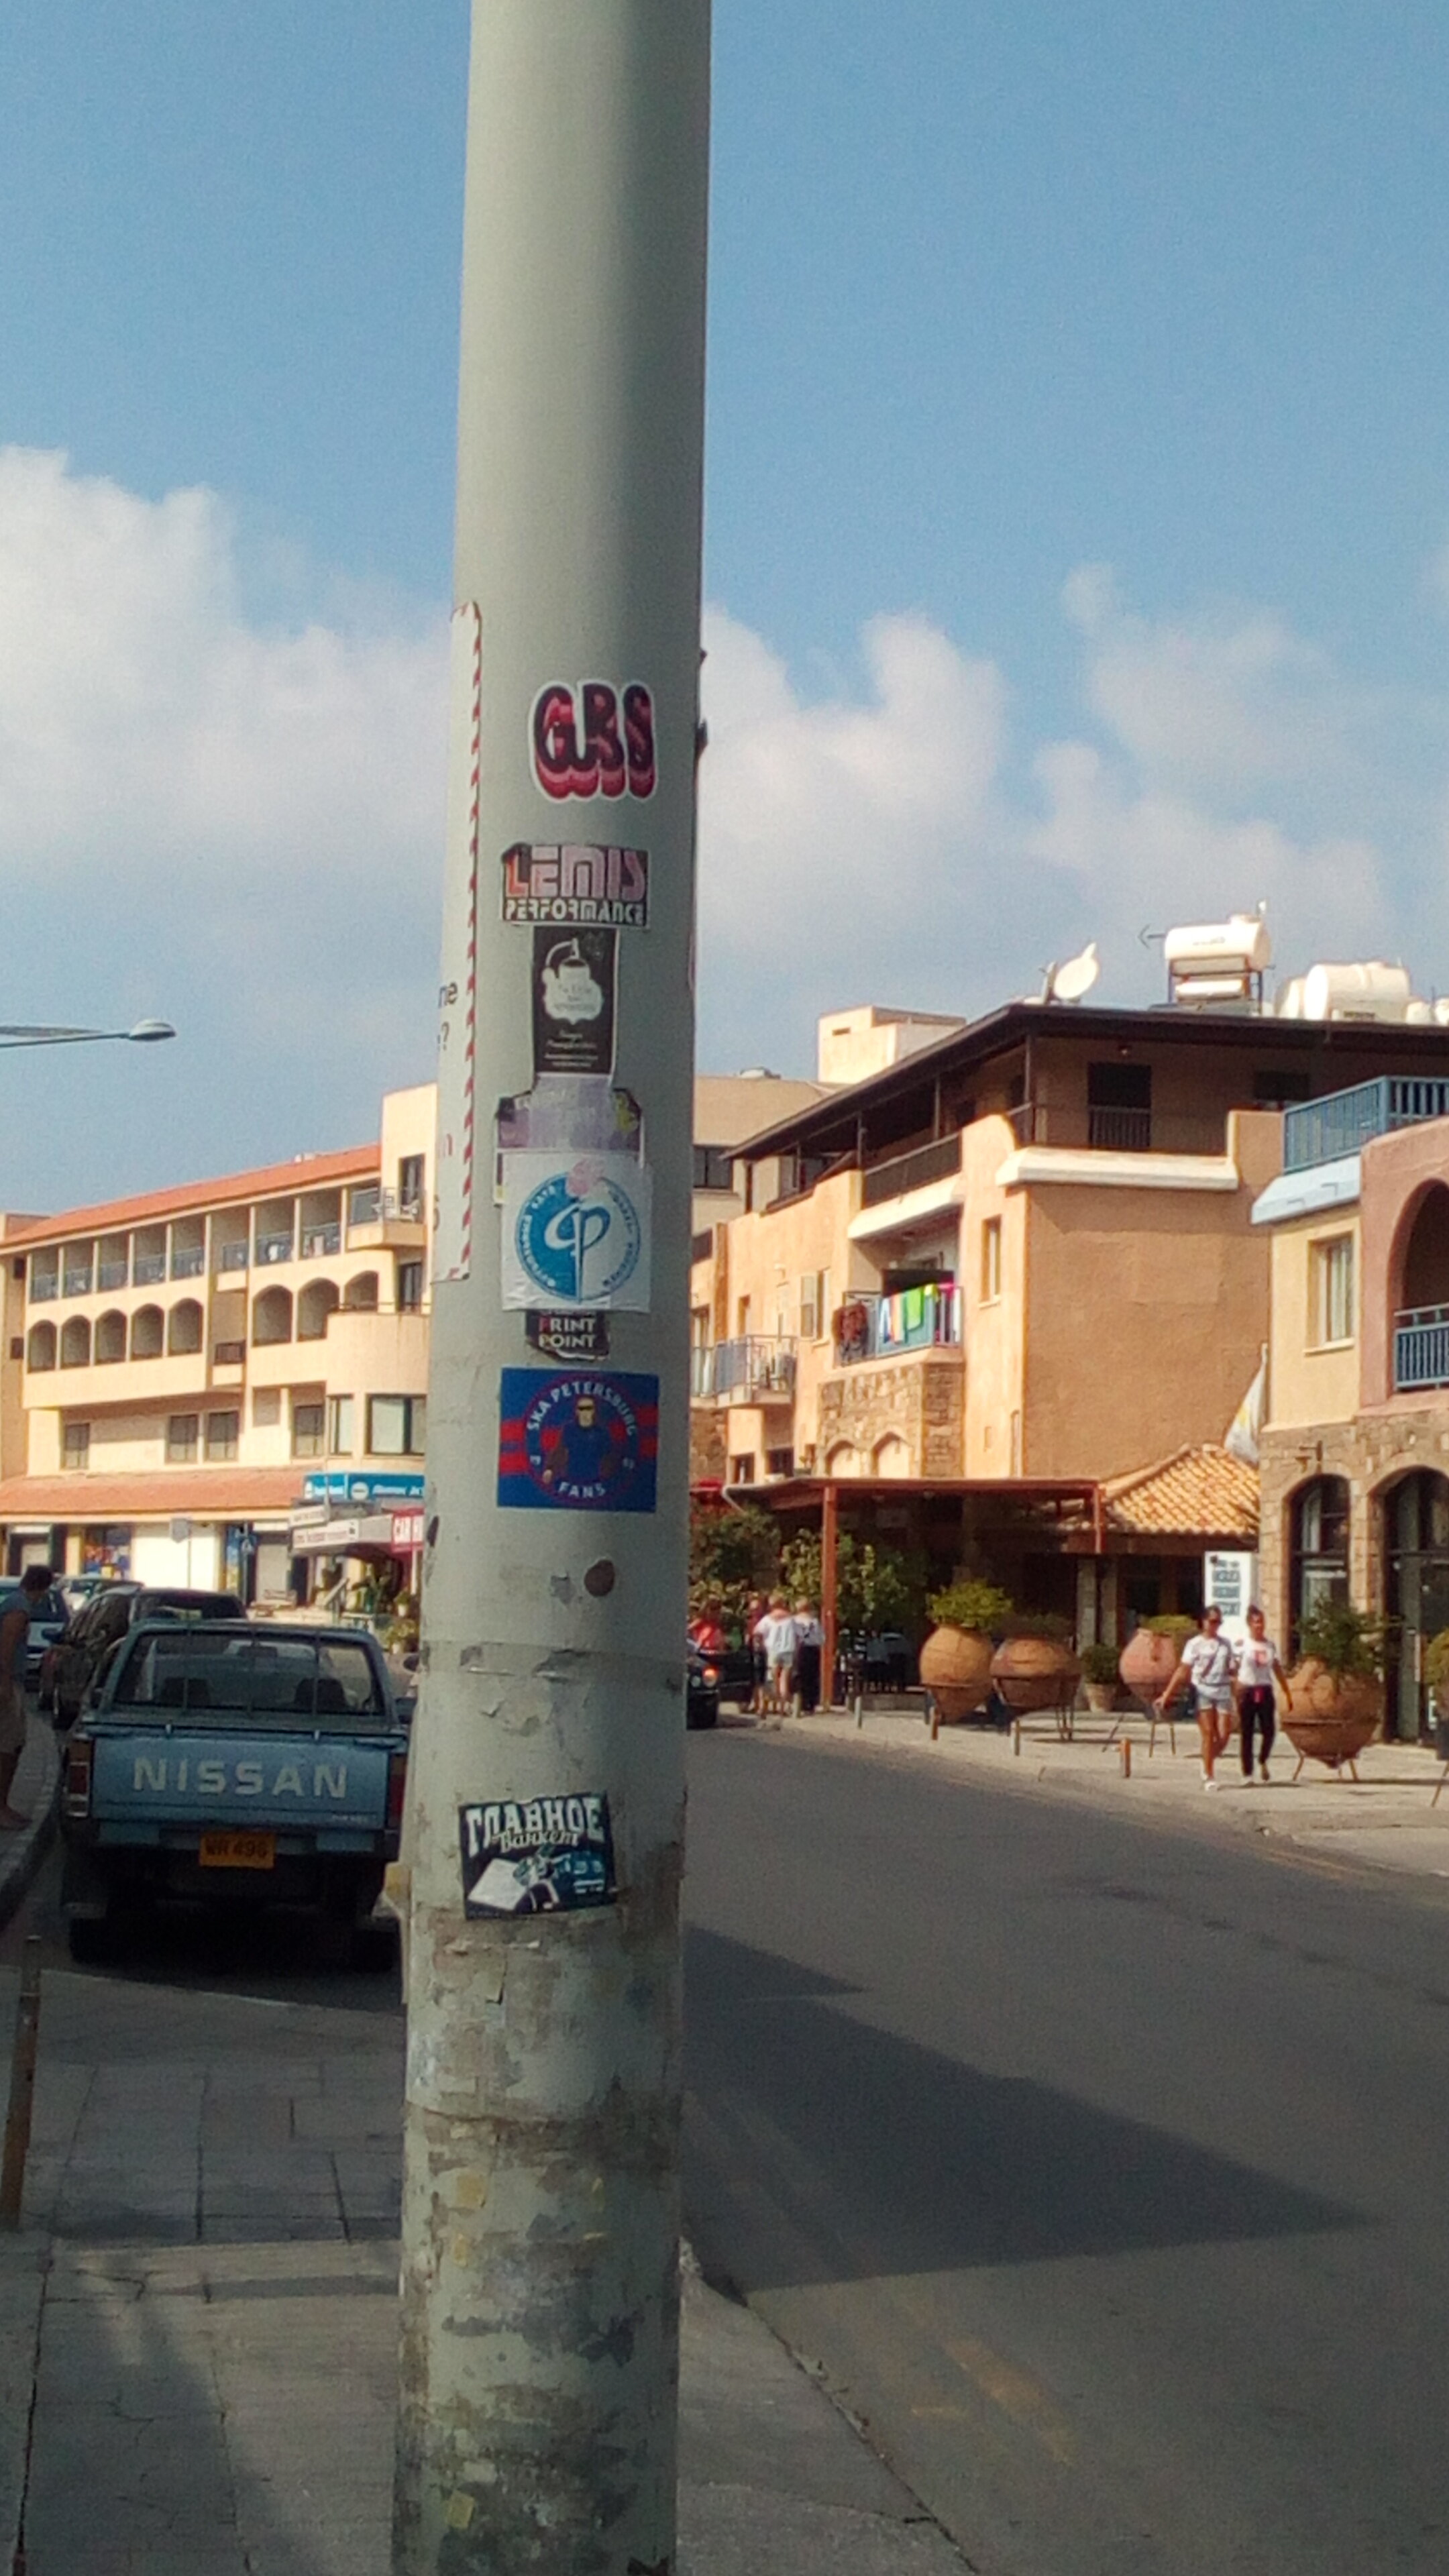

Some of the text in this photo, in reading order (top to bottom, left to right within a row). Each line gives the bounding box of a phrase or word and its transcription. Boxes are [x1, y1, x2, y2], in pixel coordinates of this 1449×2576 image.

[505, 898, 643, 924] PERFORMANCE
[539, 1317, 596, 1332] PRINT
[538, 1334, 595, 1348] POINT
[527, 1381, 637, 1436] SKA PETERSBURG
[558, 1481, 606, 1499] FANS
[133, 1758, 347, 1799] NISSAN
